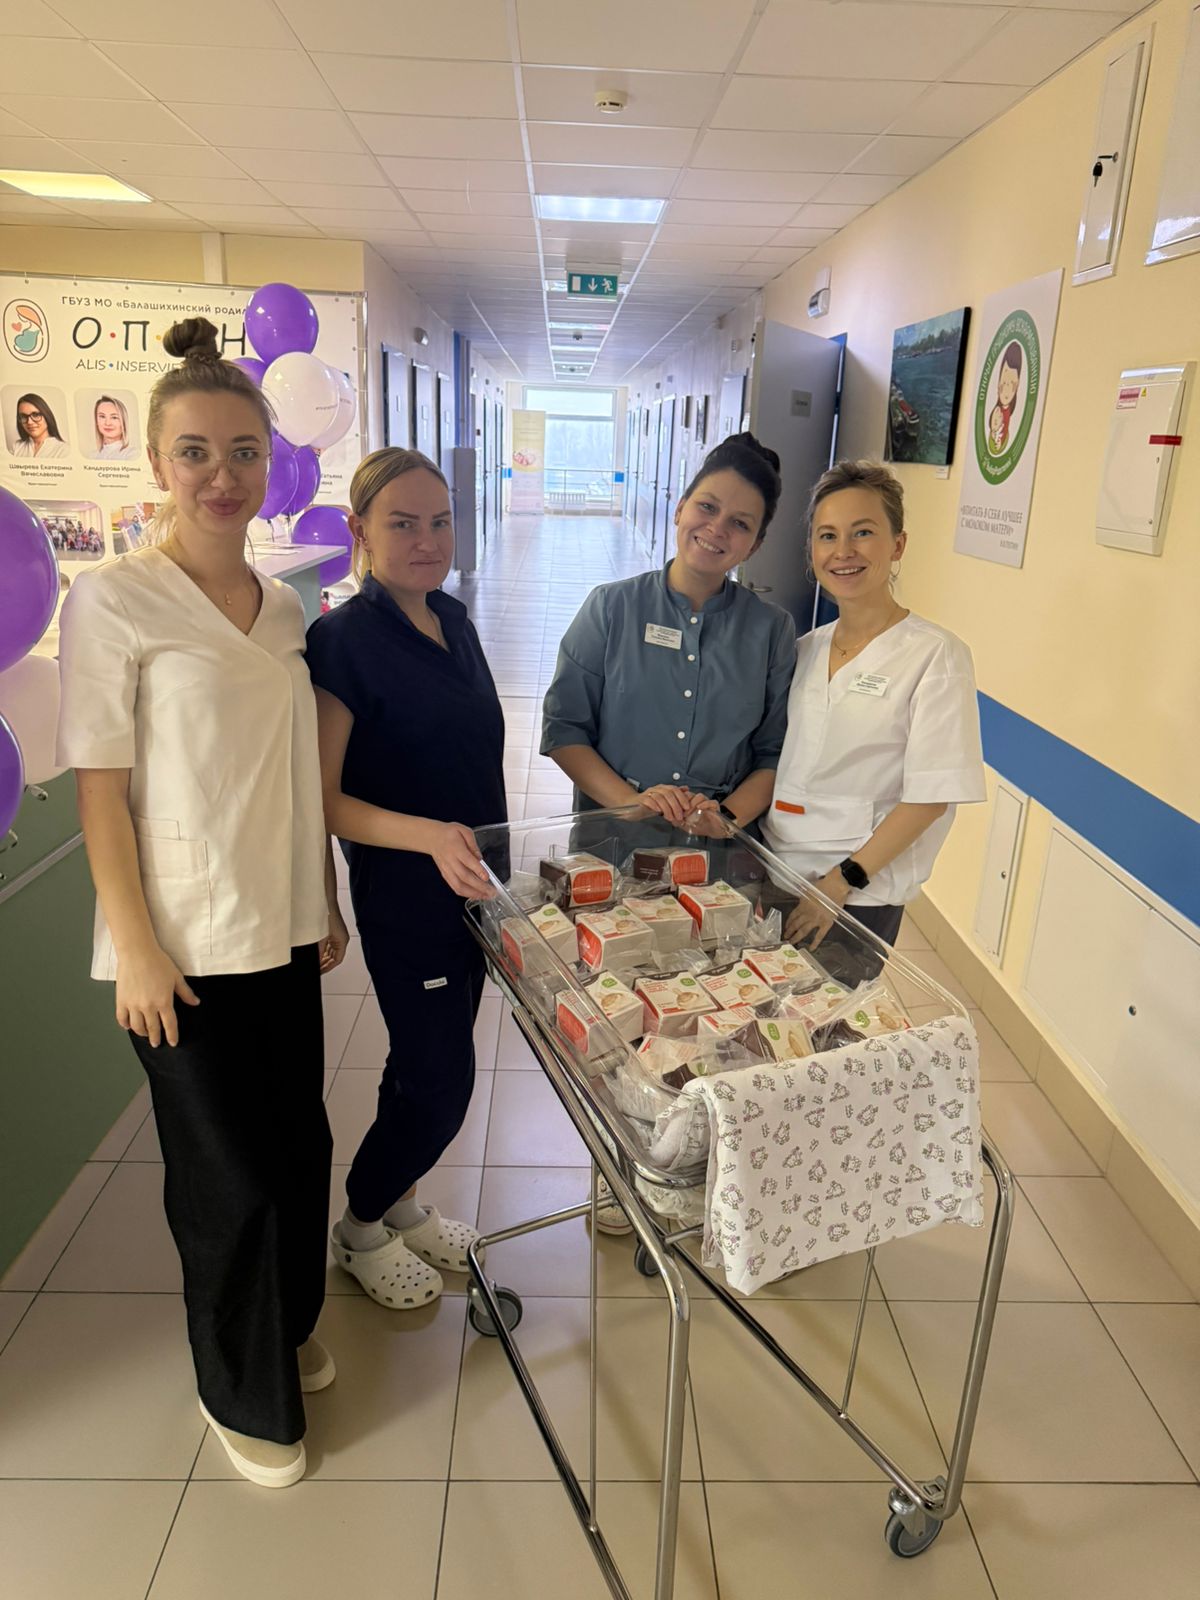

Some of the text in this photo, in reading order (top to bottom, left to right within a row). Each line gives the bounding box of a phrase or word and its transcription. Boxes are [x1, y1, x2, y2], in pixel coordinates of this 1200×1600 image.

[61, 296, 91, 307] ГБУЗ
[94, 298, 112, 308] МО
[116, 299, 211, 314] «Балашихинский
